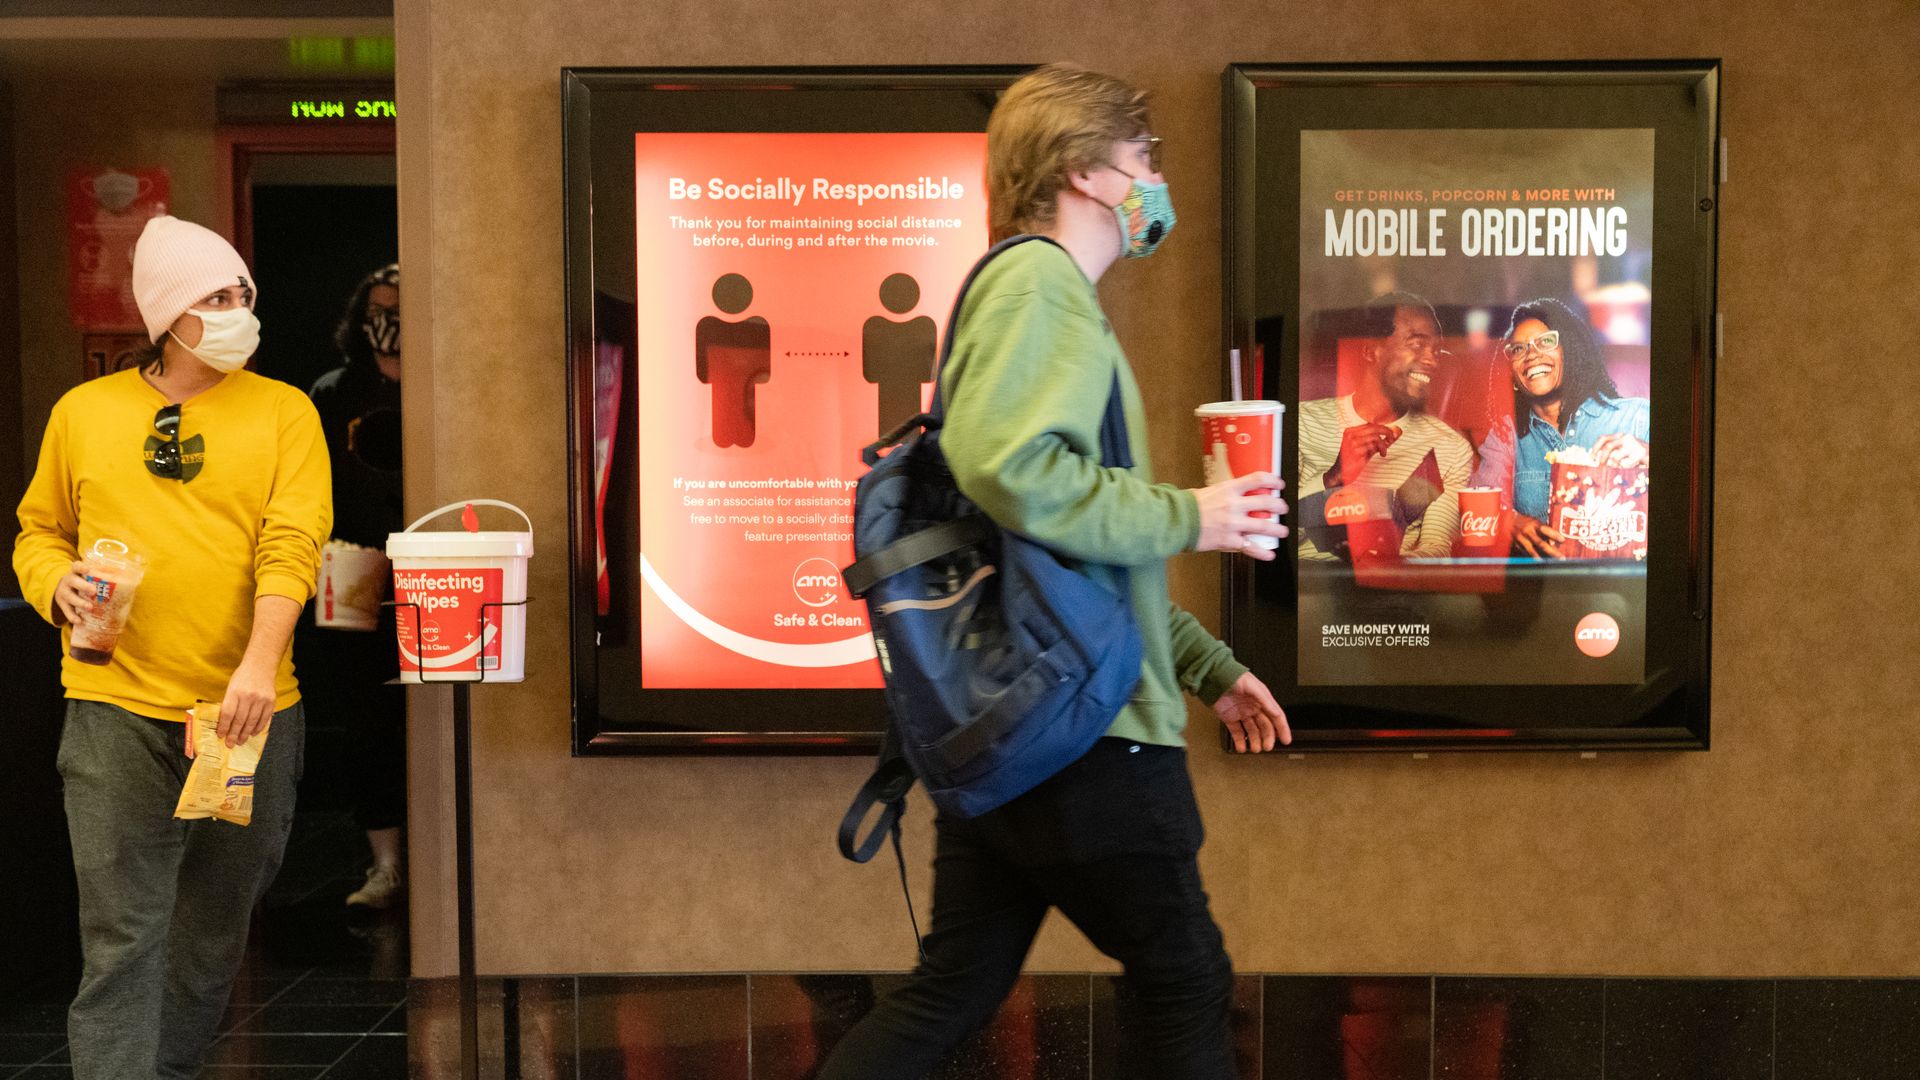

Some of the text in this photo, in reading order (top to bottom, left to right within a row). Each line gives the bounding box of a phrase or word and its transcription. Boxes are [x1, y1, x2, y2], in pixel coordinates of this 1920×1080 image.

[668, 177, 965, 206] Be Socially Responsible
[1335, 188, 1616, 203] GET DRINKS, POPCORN & MORE WITH
[669, 215, 962, 232] Thank you for maintaining social distance
[1325, 206, 1628, 257] MOBILE ORDERING
[693, 233, 939, 250] before, during and after the movie.
[673, 477, 858, 491] If you are uncomfortable with yo
[683, 496, 705, 506] See
[707, 498, 720, 506] an
[723, 496, 774, 506] associate
[777, 496, 792, 506] for
[794, 496, 851, 506] assistance
[1327, 503, 1365, 518] amc
[690, 513, 855, 527] free to move to a socially dista
[744, 531, 854, 543] feature presentation
[394, 572, 484, 593] Disinfecting
[796, 575, 838, 587] amc
[406, 591, 460, 613] Wipes
[774, 613, 805, 627] Safe
[808, 614, 818, 627] &
[1321, 624, 1430, 635] SAVE MONEY WITH
[1577, 628, 1617, 640] amc
[1322, 636, 1430, 647] EXCLUSIVE OFFERS
